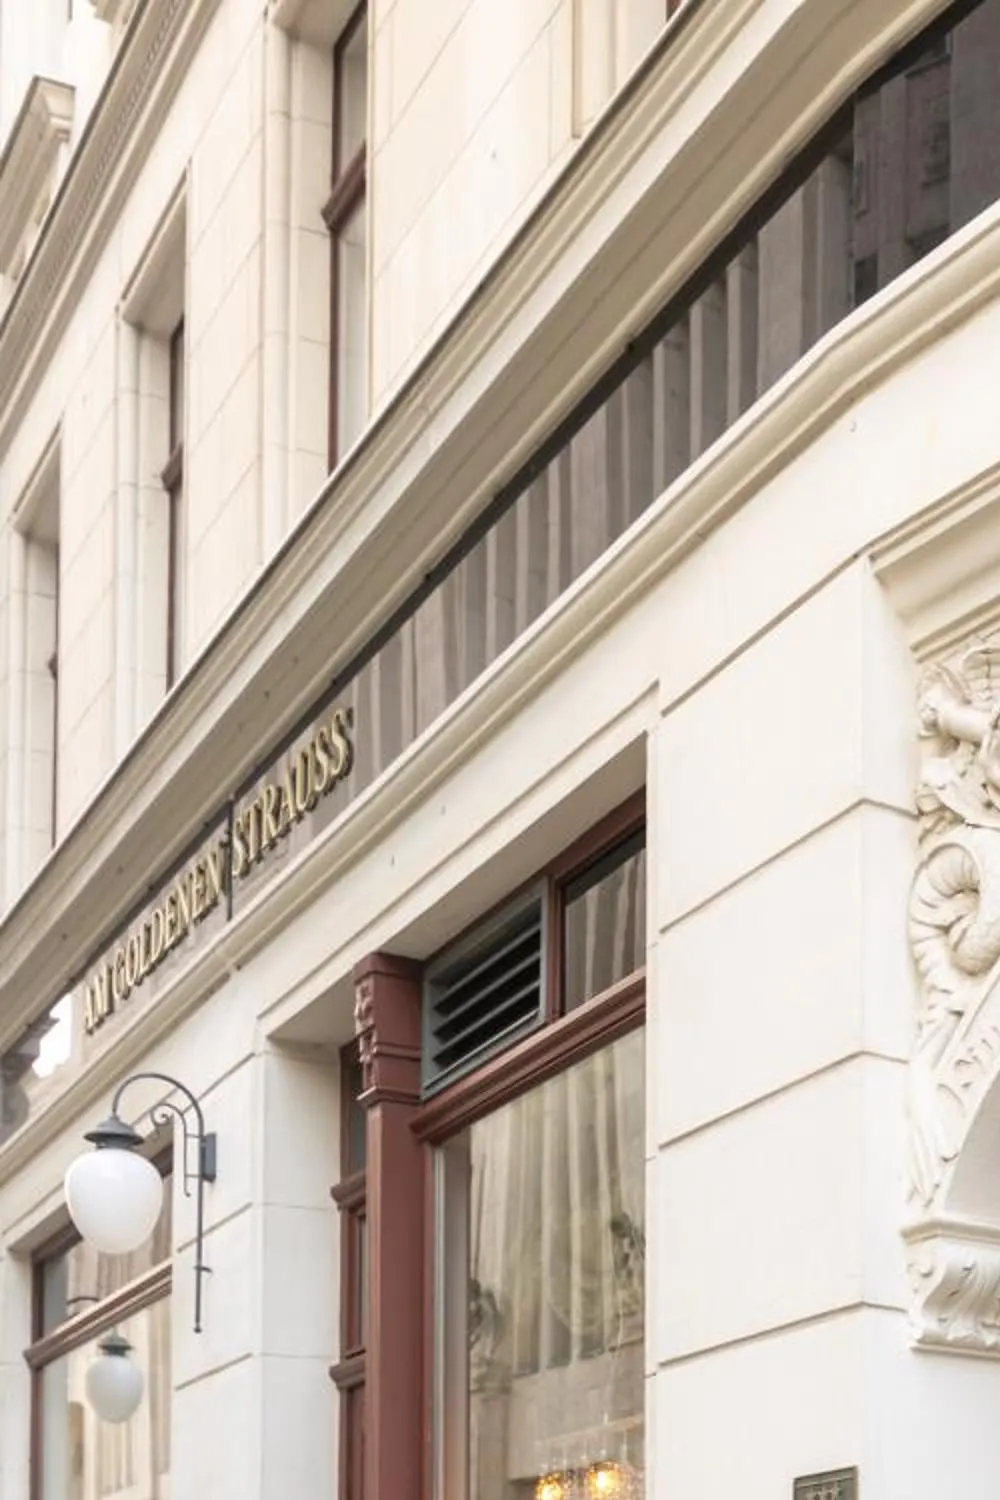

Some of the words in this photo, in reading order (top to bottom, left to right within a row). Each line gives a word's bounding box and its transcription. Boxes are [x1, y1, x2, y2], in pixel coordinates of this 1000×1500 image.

[84, 963, 116, 1035] AM
[112, 843, 228, 1002] GOLDENEN
[231, 706, 353, 880] STRAUSS
